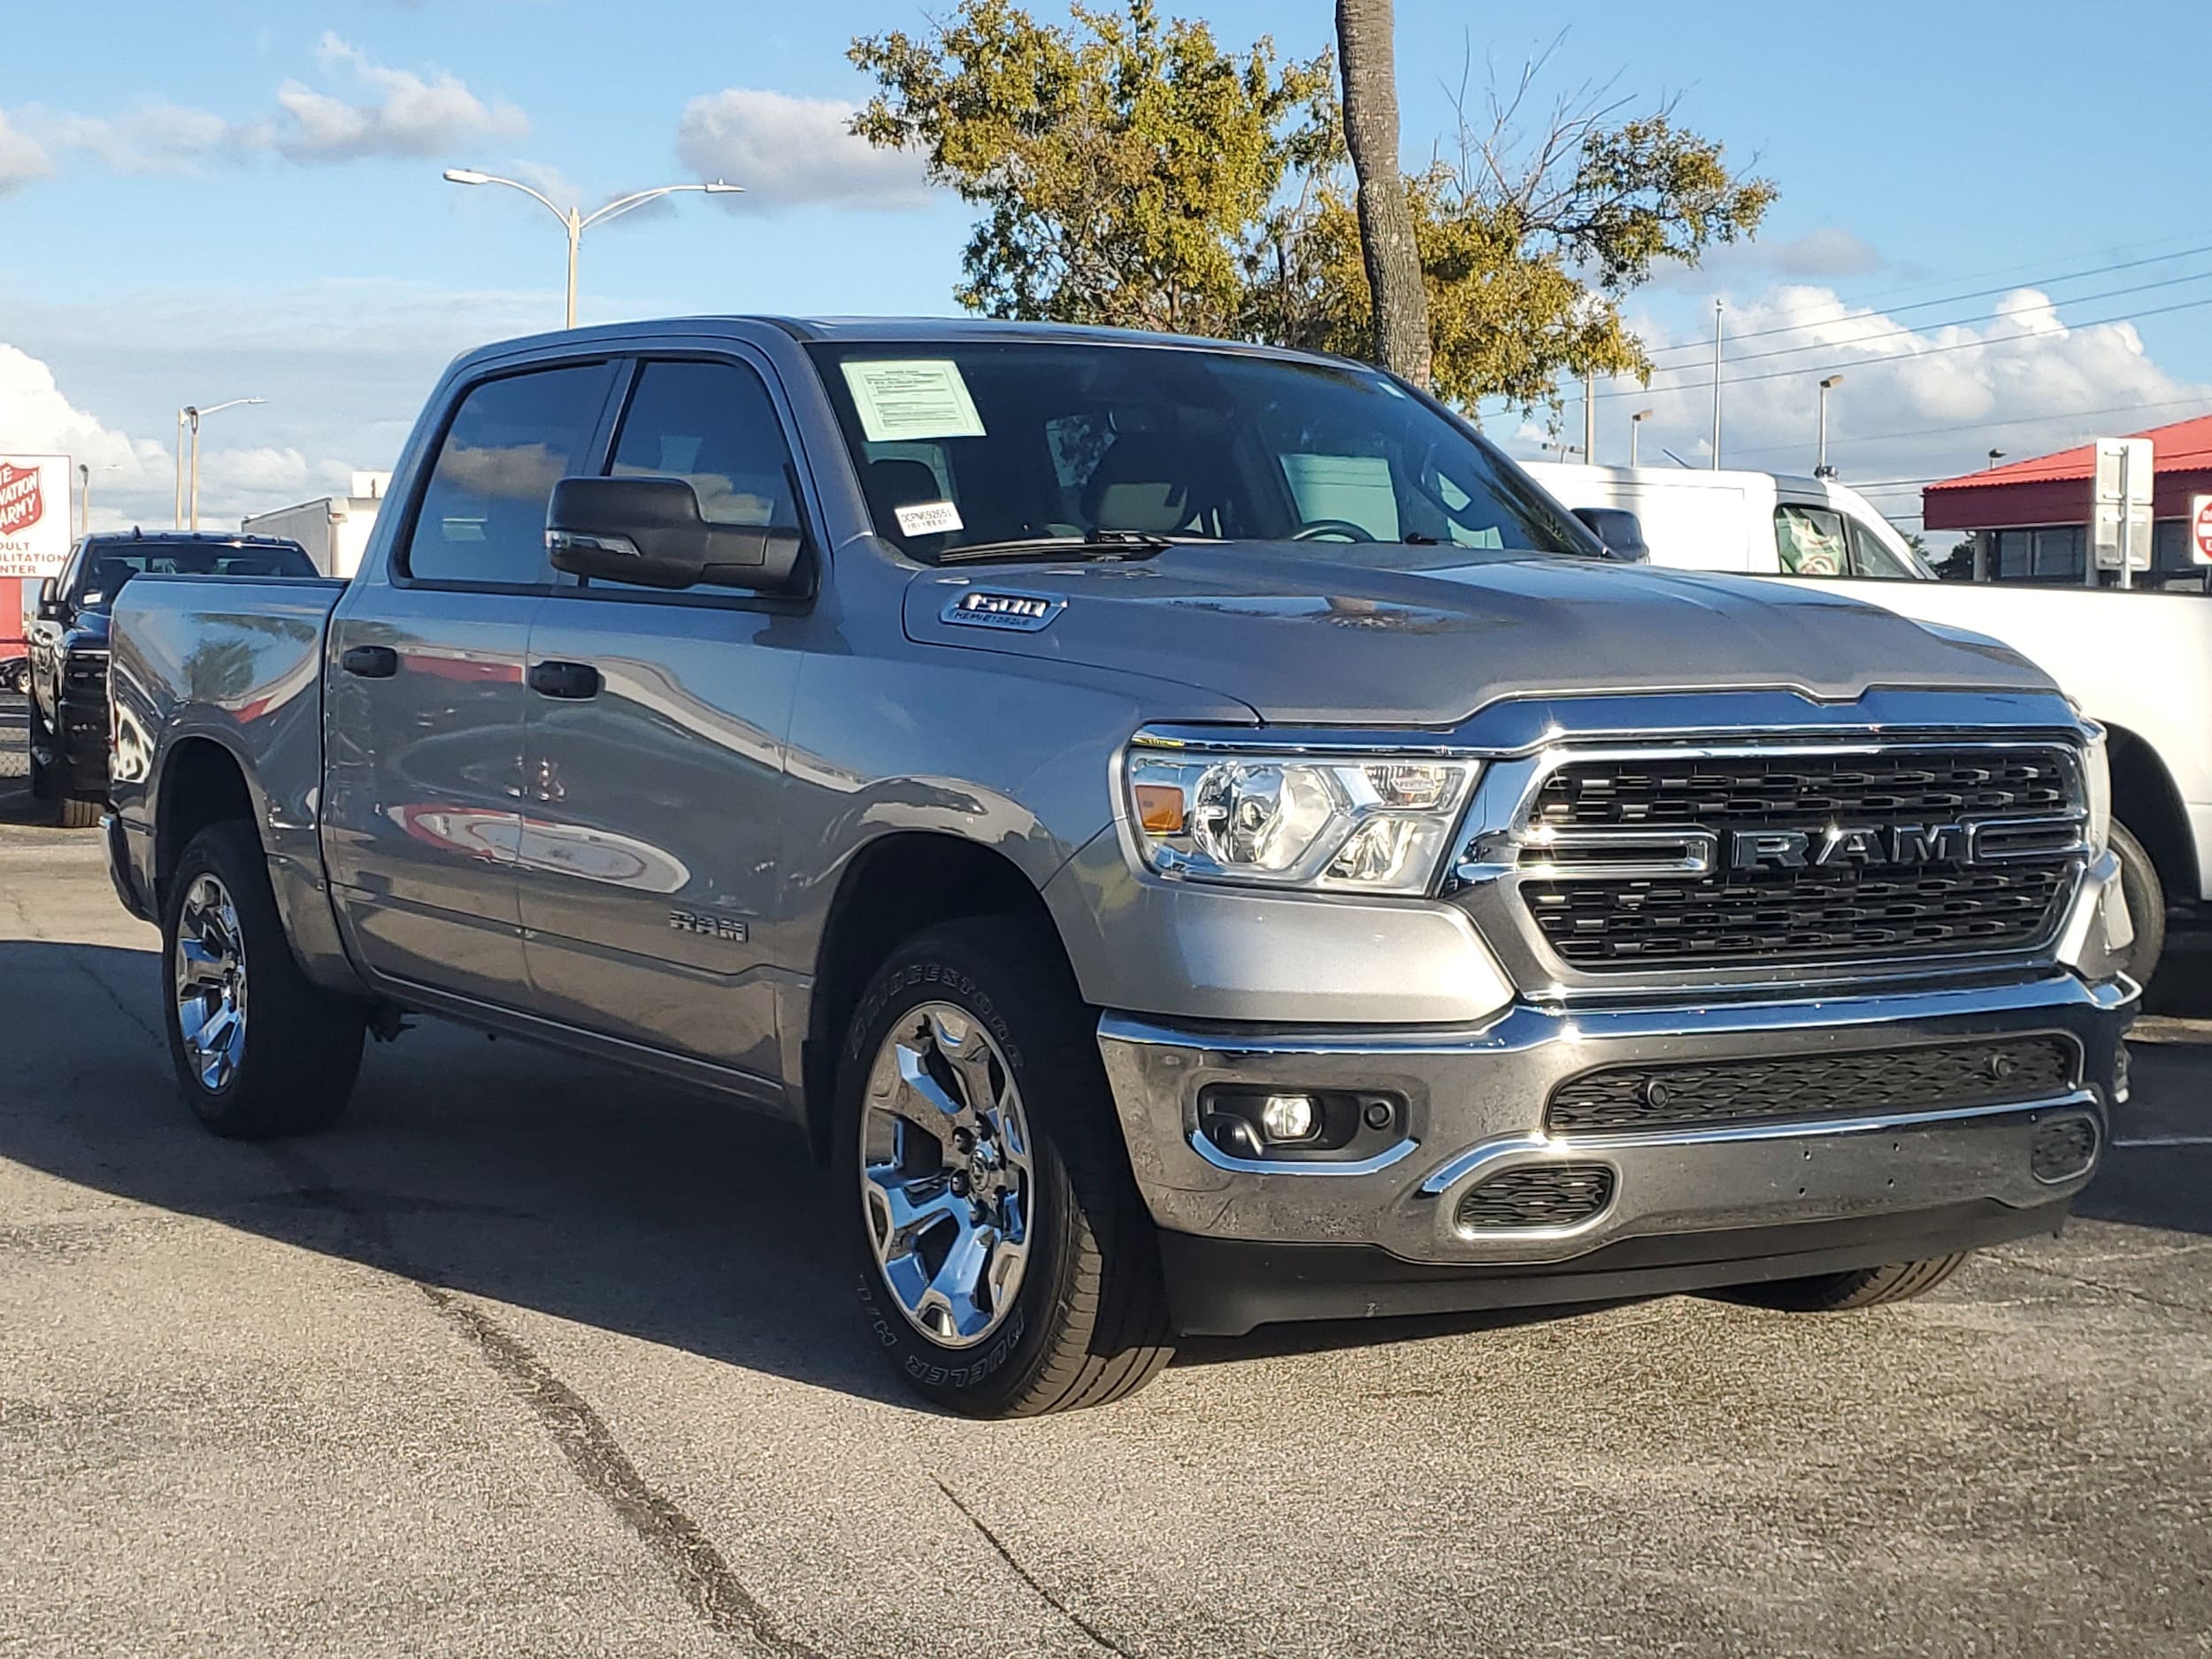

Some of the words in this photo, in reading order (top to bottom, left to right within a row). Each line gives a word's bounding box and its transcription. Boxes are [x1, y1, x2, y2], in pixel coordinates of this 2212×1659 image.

[1733, 824, 1962, 866] RAM
[670, 910, 749, 942] RAM
[903, 1305, 1025, 1388] DUELER
